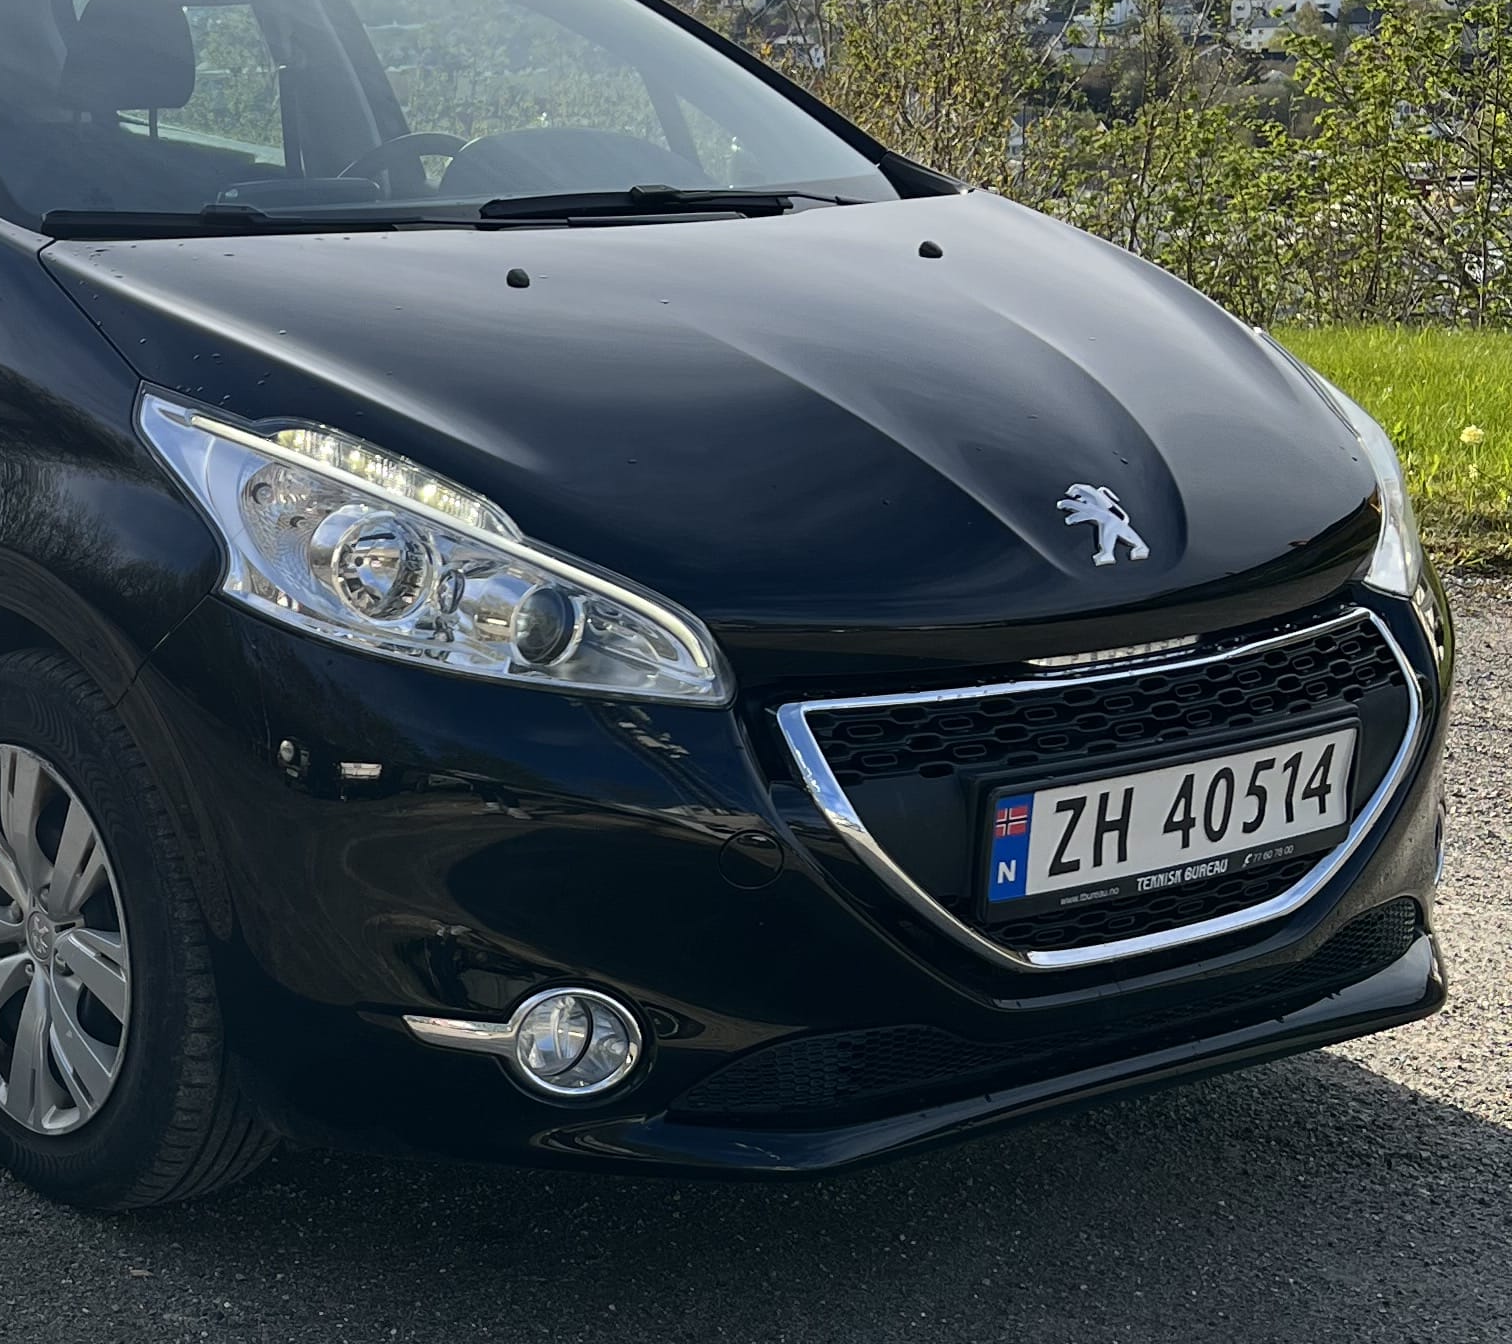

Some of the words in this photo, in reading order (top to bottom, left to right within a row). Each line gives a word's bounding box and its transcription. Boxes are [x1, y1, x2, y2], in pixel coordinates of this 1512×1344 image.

[1047, 786, 1136, 878] ZH
[1162, 743, 1337, 850] 40514
[997, 859, 1018, 885] N
[1136, 869, 1183, 892] TEKNISK
[1184, 858, 1229, 881] BUREAU
